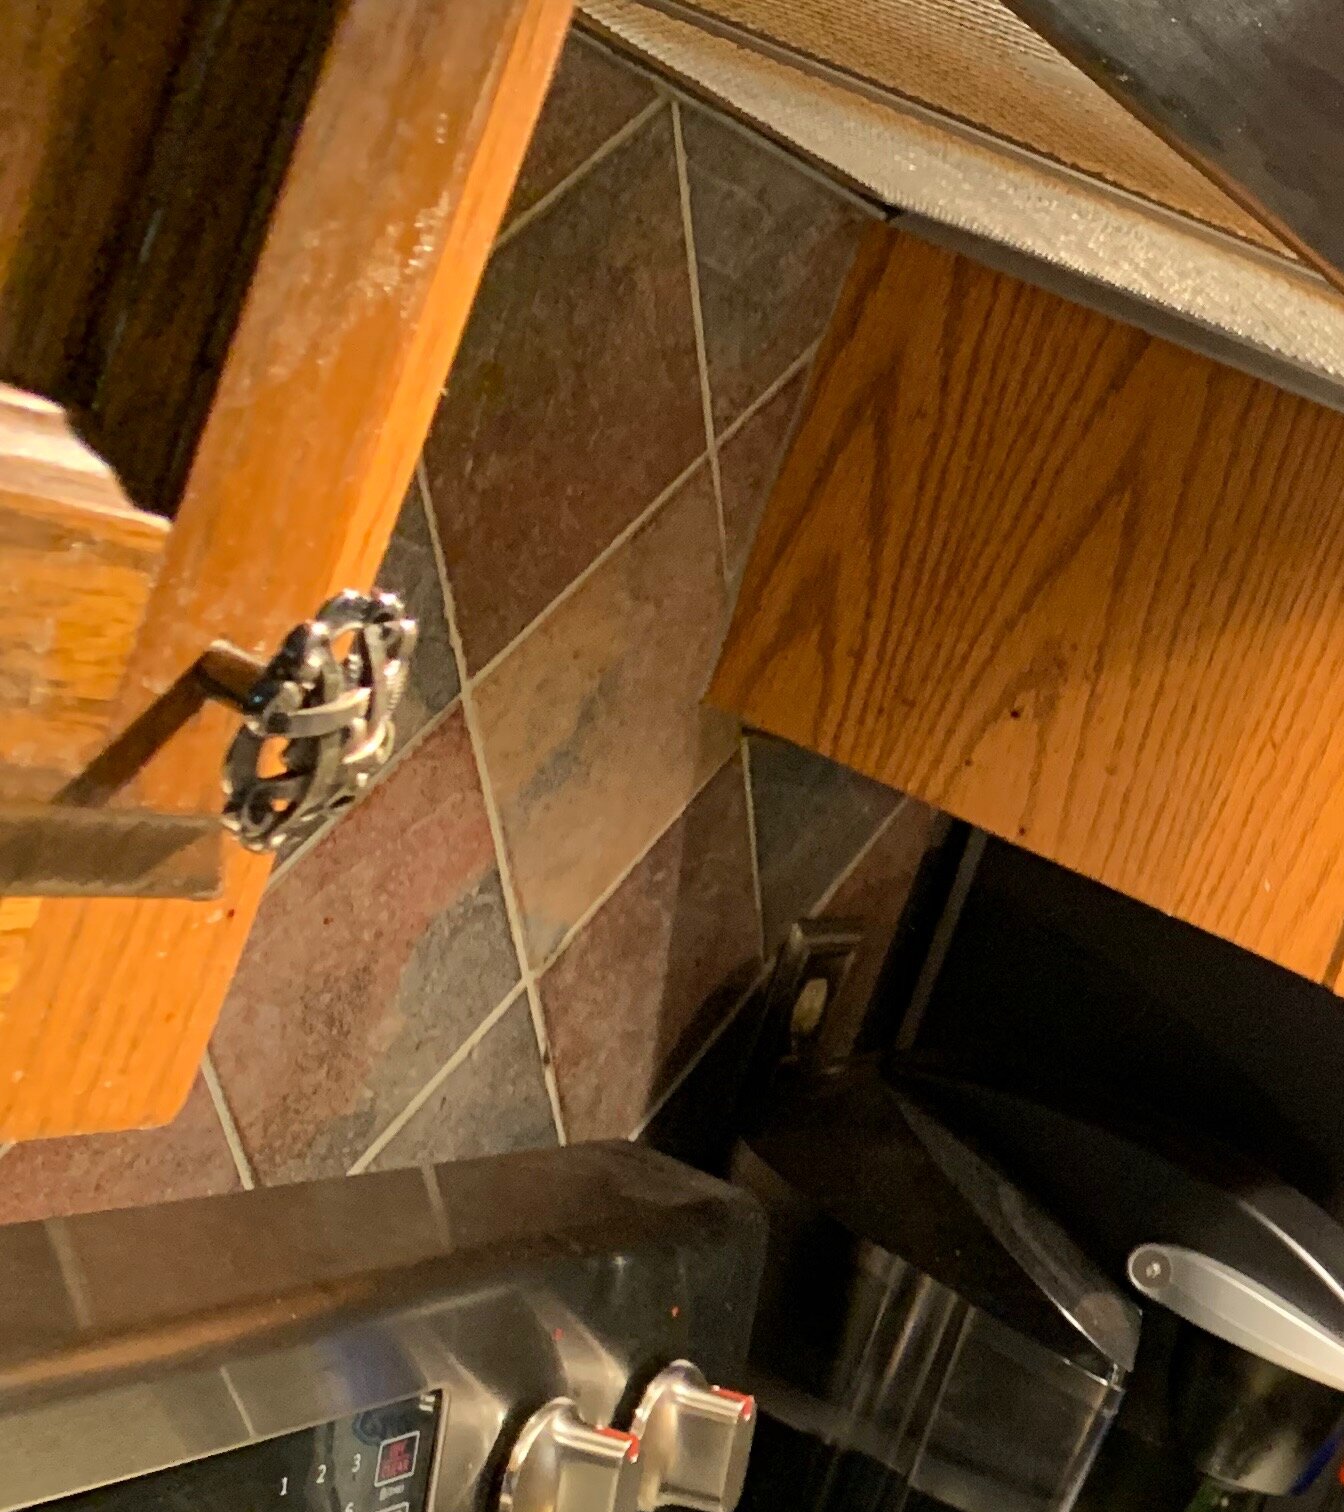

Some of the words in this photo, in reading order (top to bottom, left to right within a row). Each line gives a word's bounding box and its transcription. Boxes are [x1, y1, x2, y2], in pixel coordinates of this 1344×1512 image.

[352, 1453, 361, 1473] 3
[316, 1464, 327, 1484] 2
[280, 1476, 288, 1496] 1
